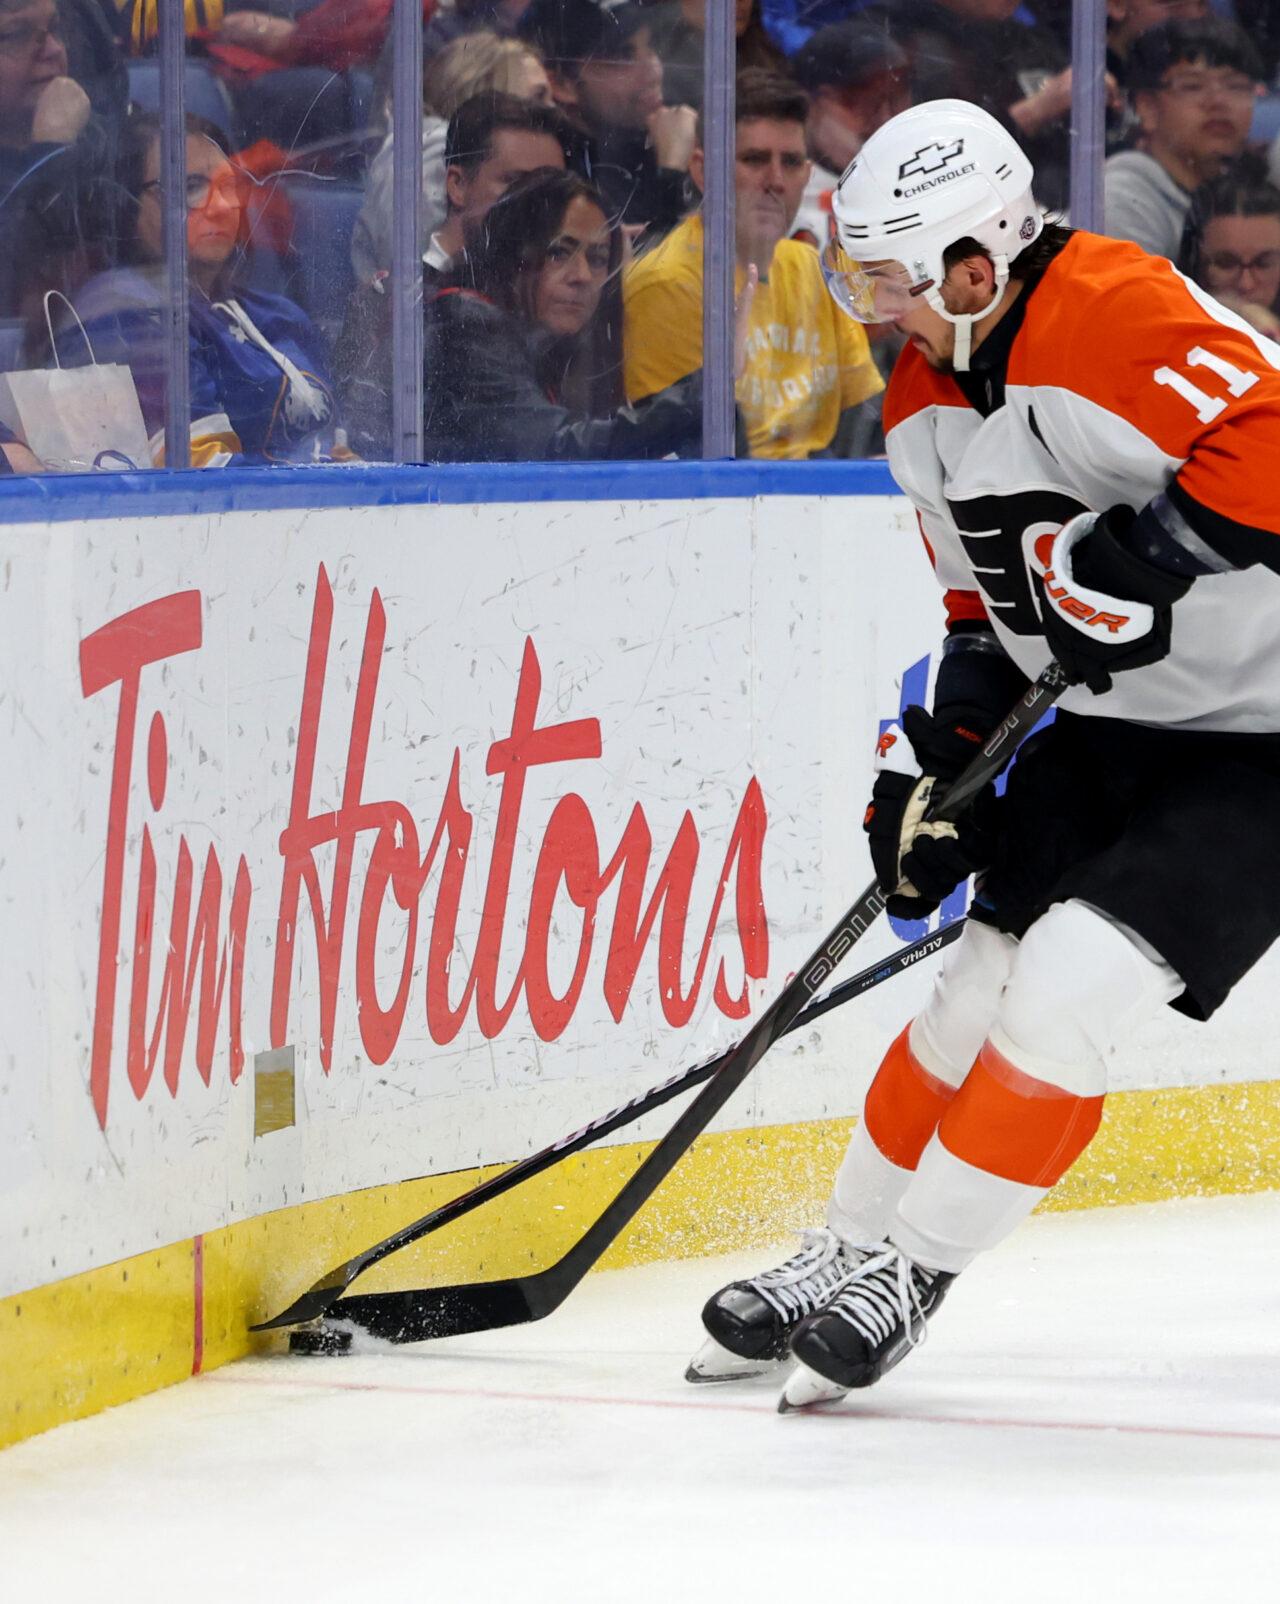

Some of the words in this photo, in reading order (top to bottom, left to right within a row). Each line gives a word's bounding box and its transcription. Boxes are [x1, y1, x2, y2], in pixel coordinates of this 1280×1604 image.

[904, 162, 977, 199] CHEVROLET
[1153, 345, 1261, 424] 11
[80, 589, 252, 1131] Tim
[269, 561, 770, 1077] Hortons
[901, 936, 943, 967] ALPHA
